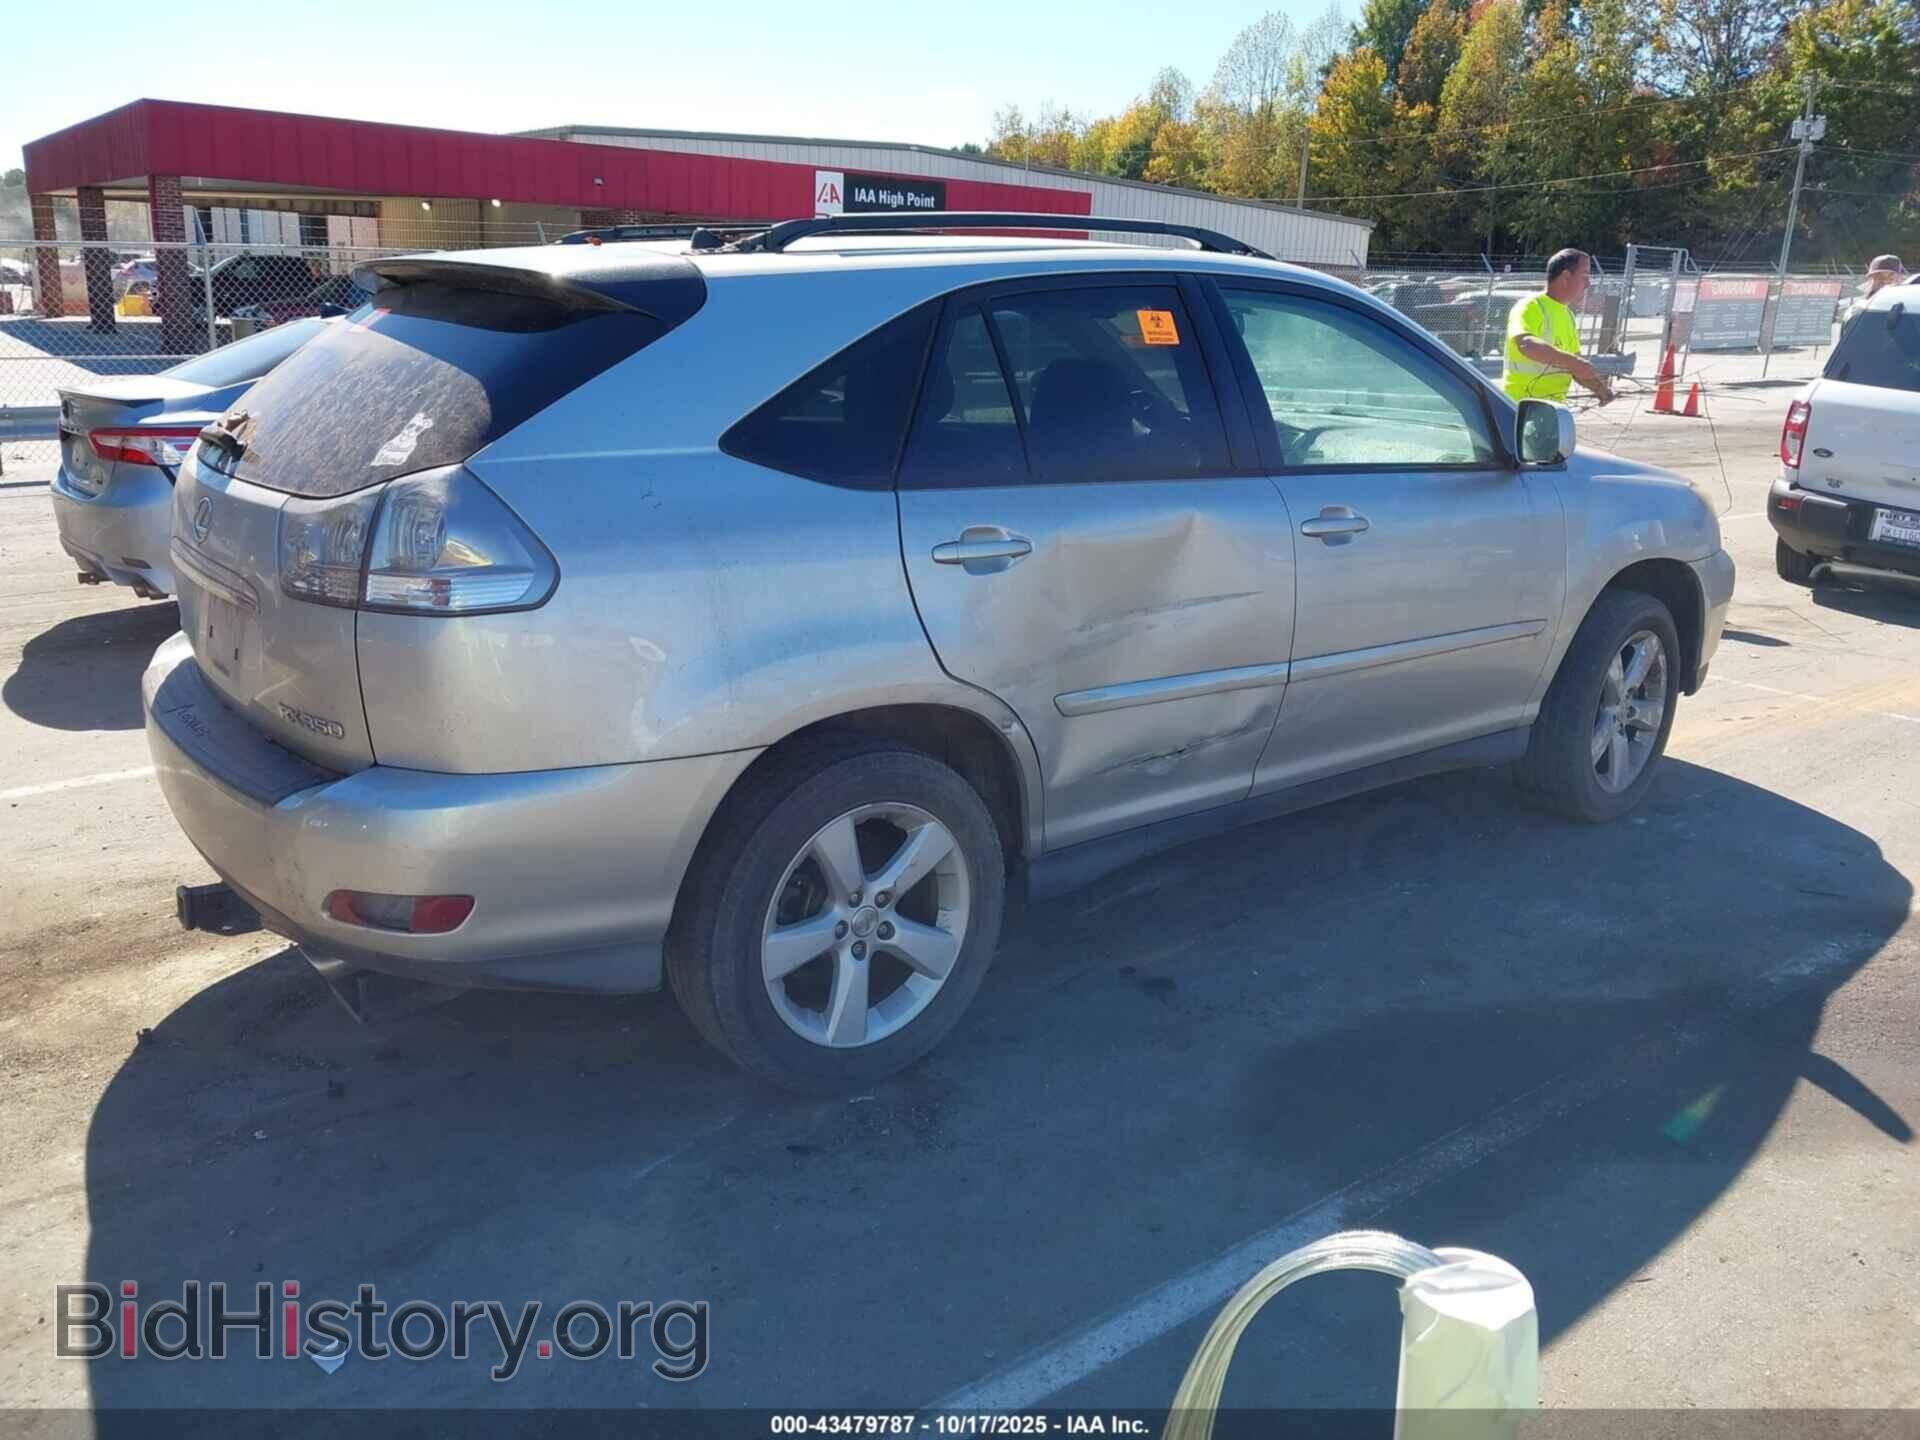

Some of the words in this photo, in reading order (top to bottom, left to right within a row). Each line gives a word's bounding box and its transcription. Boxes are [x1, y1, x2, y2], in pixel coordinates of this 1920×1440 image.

[855, 188, 876, 203] IAA
[880, 190, 904, 208] High
[907, 192, 935, 208] Point
